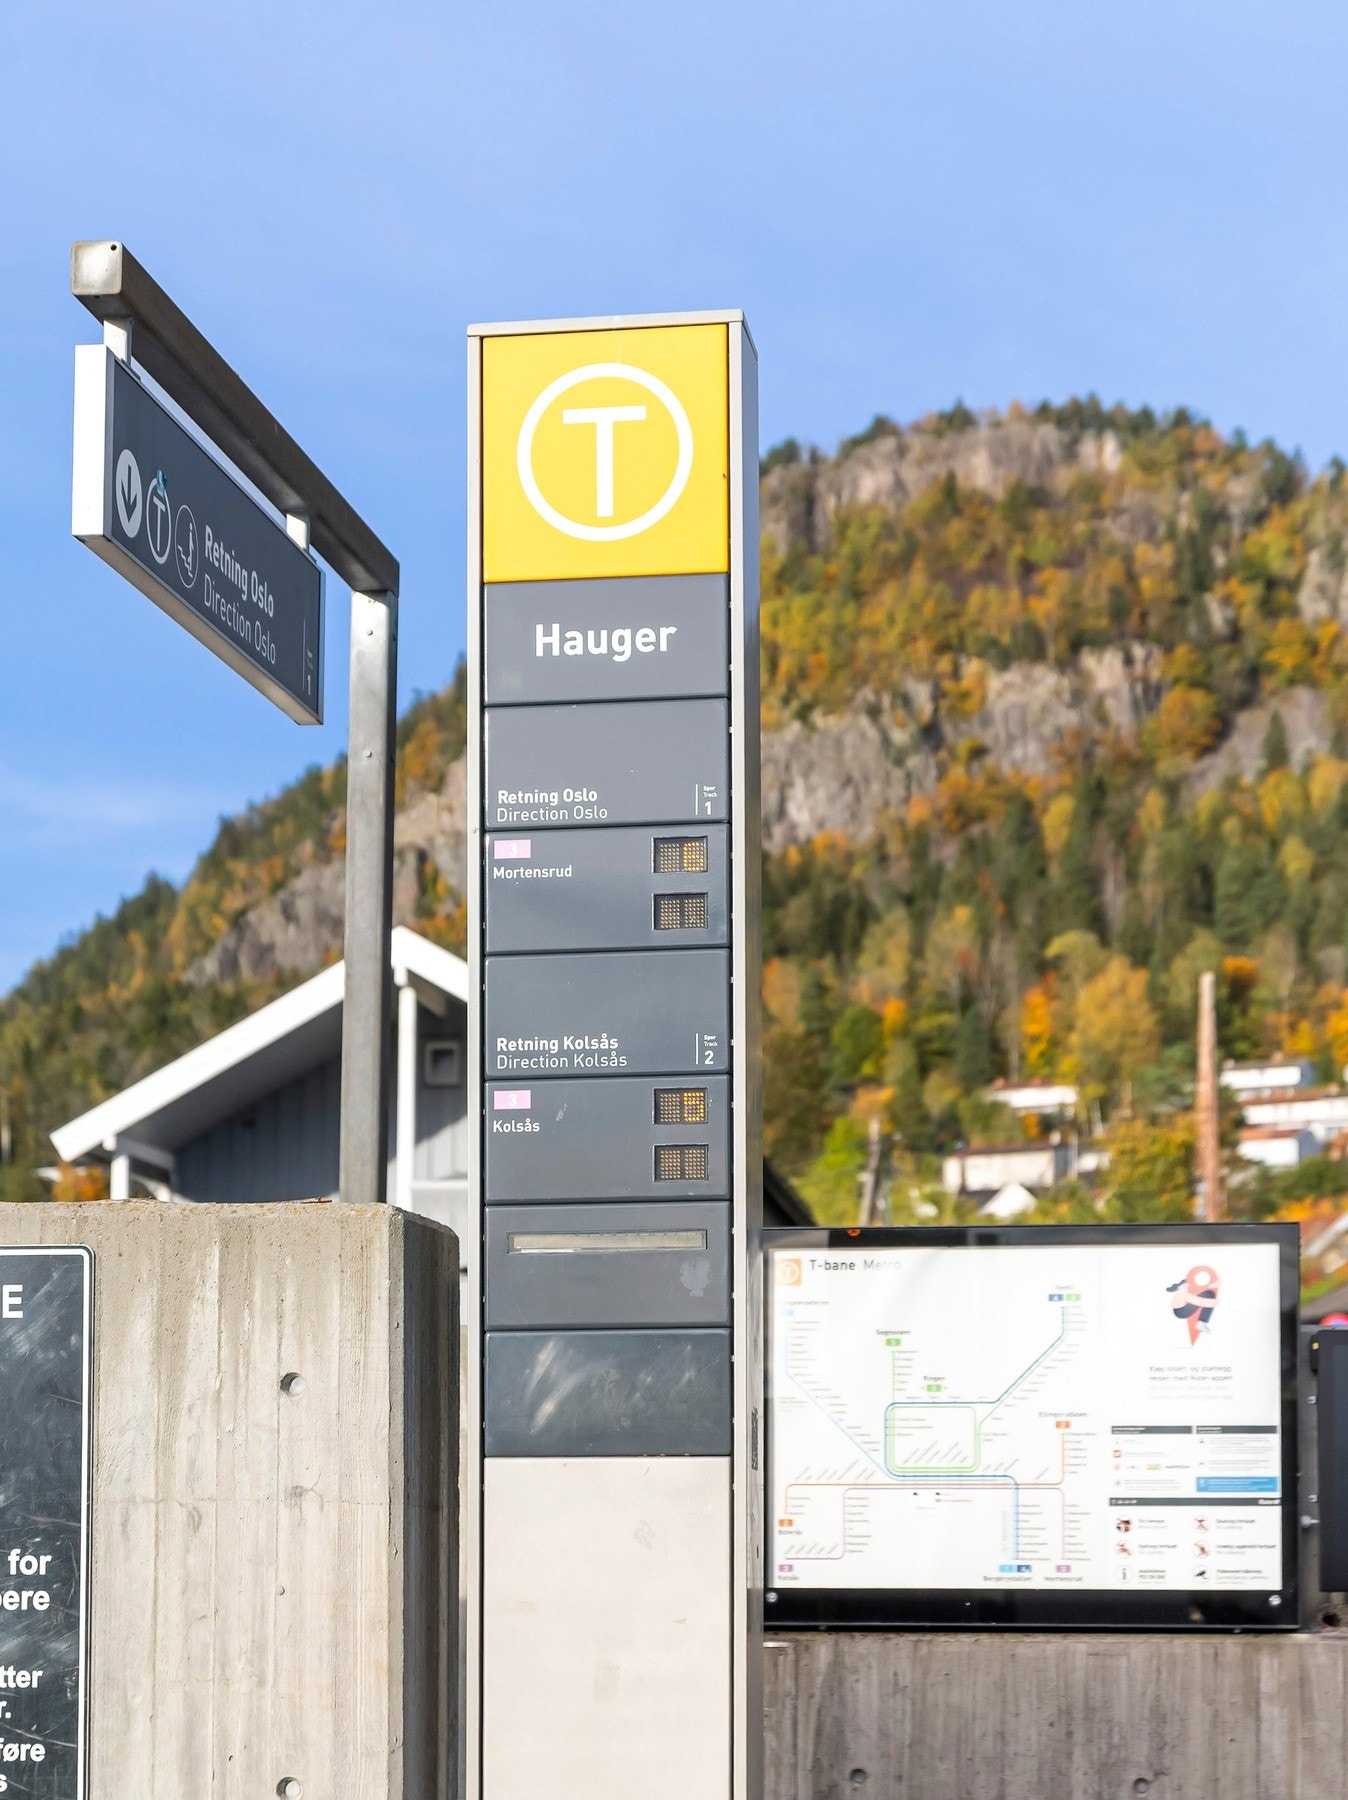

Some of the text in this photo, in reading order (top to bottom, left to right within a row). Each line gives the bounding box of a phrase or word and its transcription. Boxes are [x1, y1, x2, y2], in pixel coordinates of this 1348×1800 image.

[205, 524, 274, 618] Retning Oslo
[204, 573, 276, 665] Direction Oslo
[535, 622, 677, 662] Hauger
[497, 787, 598, 806] Retning Oslo
[496, 804, 608, 822] Direction Oslo
[704, 800, 712, 816] 1
[507, 842, 518, 858] 3
[683, 842, 704, 871] 6
[493, 864, 572, 879] Mortensrud
[496, 1033, 619, 1054] Retning Kolsås
[496, 1050, 628, 1069] Direction Kolsås
[704, 1050, 714, 1065] 2
[508, 1093, 518, 1108] 3
[683, 1092, 705, 1122] 5
[493, 1117, 540, 1133] Kolsås
[809, 1259, 856, 1271] T-bane
[2, 1284, 24, 1319] E
[8, 1548, 53, 1576] for
[0, 1589, 51, 1611] ere
